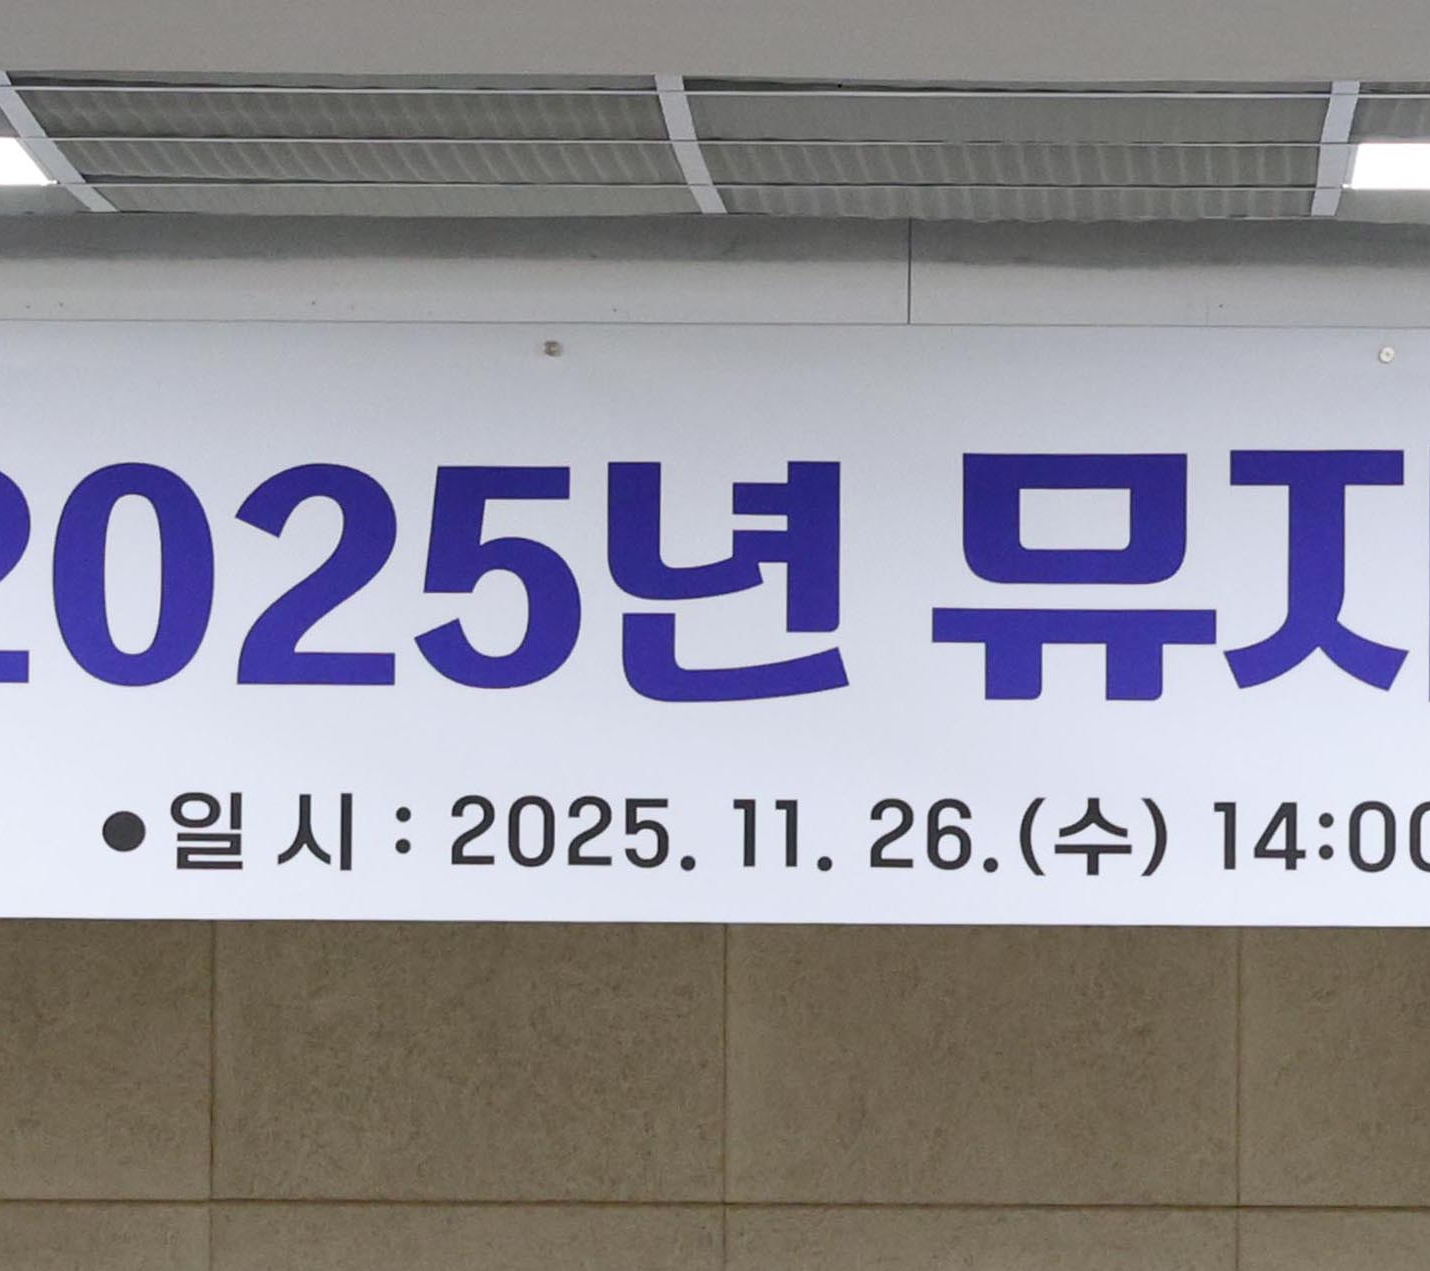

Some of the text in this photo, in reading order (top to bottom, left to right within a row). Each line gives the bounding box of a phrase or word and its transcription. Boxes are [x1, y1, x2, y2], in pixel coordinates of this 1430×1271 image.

[170, 792, 243, 870] 일
[451, 795, 696, 871] 2025.
[733, 799, 833, 872] 11.
